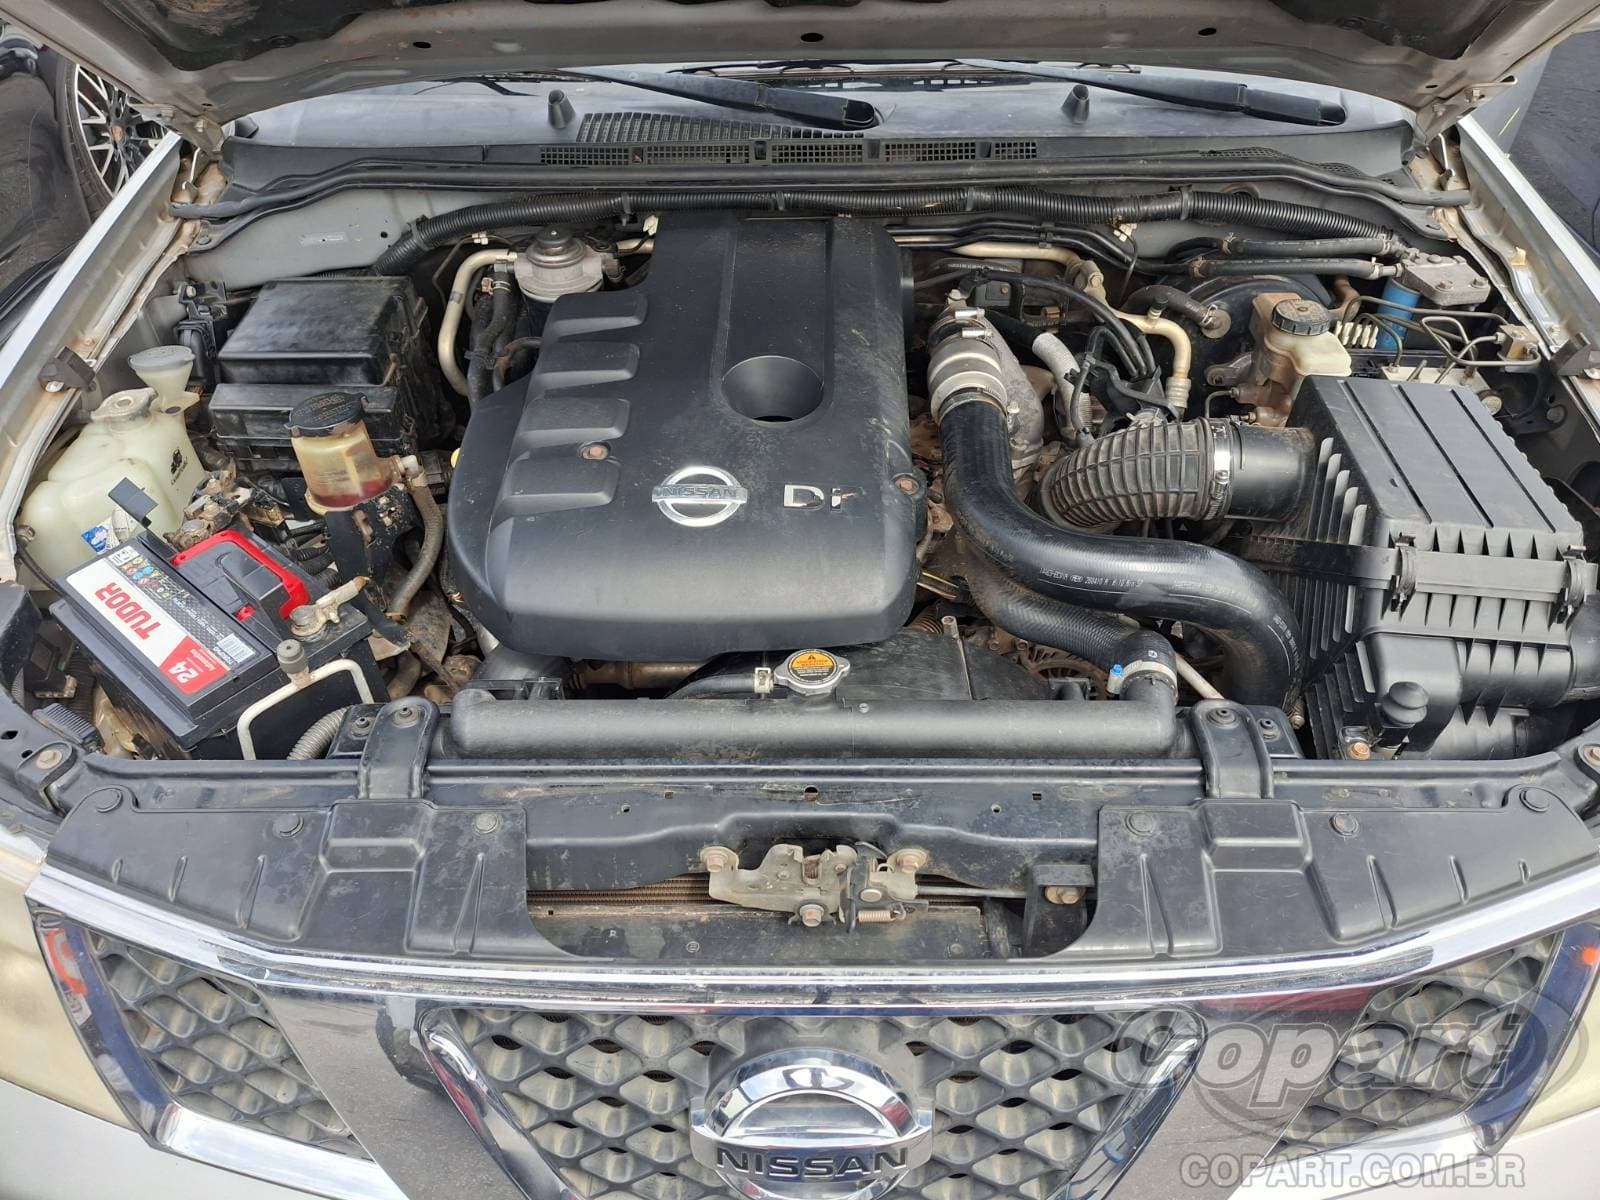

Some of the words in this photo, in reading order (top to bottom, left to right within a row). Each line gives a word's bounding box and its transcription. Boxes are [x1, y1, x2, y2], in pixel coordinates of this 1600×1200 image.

[658, 486, 738, 498] NISSAN
[95, 582, 161, 641] TUDOR
[168, 661, 200, 684] 24
[716, 1148, 908, 1178] NISSAN
